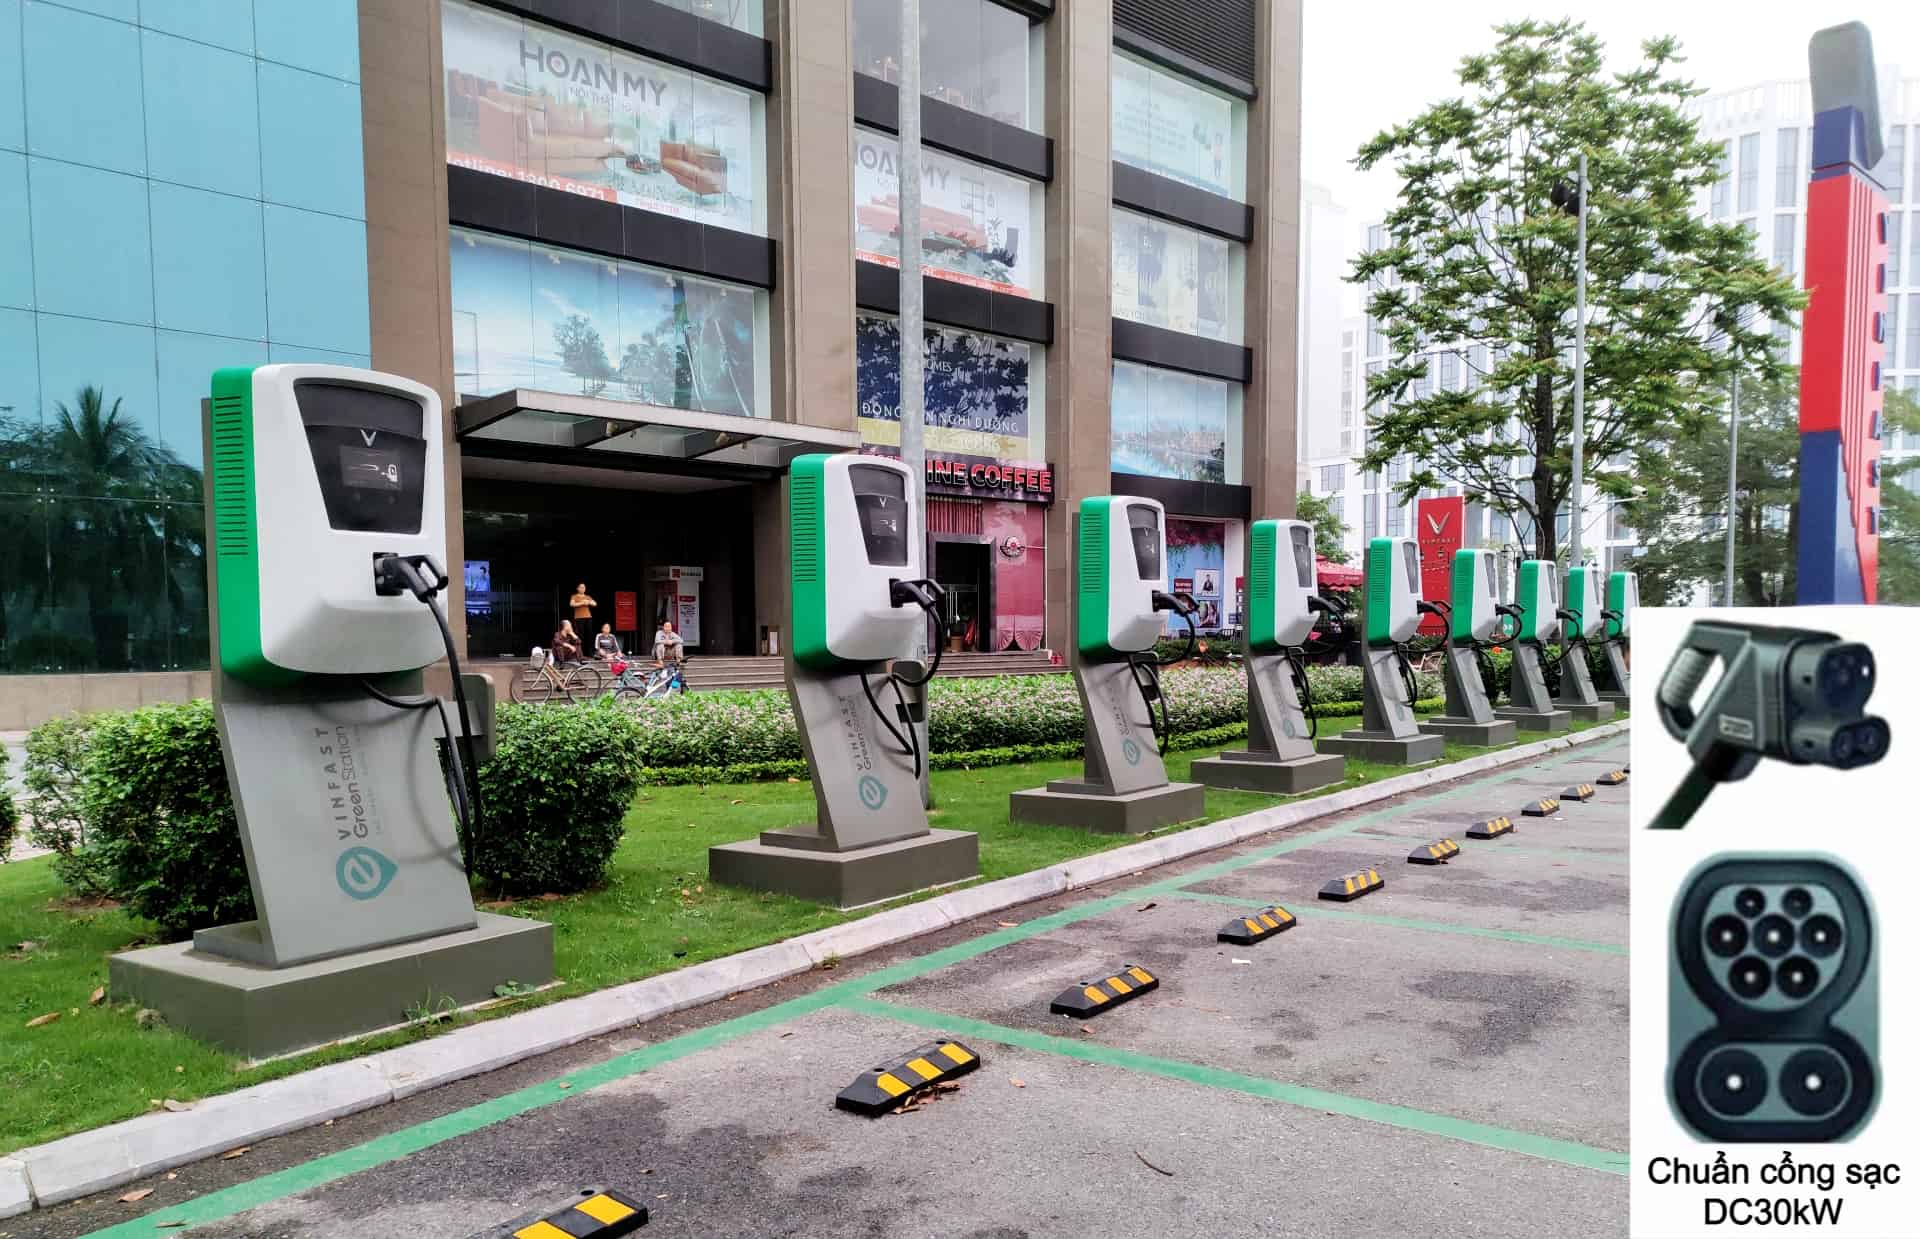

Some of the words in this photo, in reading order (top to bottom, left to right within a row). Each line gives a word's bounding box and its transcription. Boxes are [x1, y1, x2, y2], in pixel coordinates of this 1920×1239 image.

[927, 457, 969, 485] INE
[971, 463, 1052, 493] COFFEE
[335, 725, 356, 781] Station
[315, 727, 352, 841] VINFAST
[348, 781, 368, 839] Green
